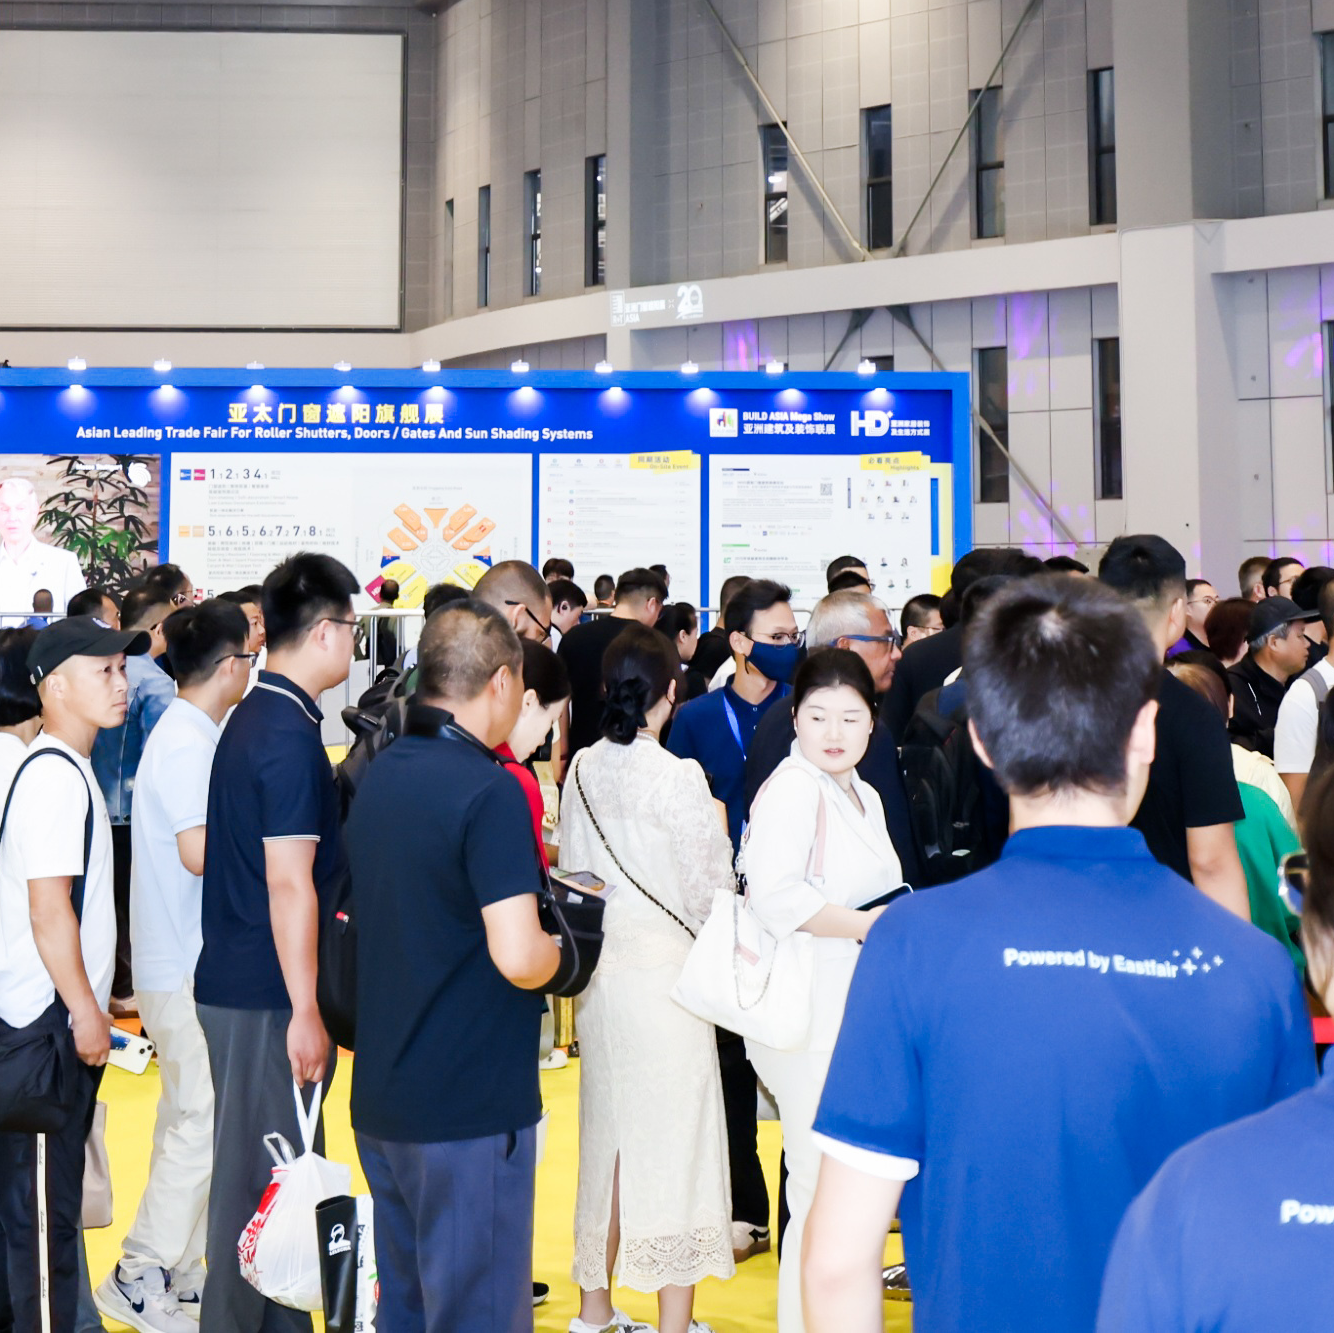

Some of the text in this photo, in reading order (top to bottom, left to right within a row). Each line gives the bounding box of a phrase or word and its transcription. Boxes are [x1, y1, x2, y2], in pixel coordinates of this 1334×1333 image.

[227, 402, 445, 425] 亚太门窗遮阳旗舰展
[743, 411, 835, 423] BUILD ASIA Mega Show
[76, 426, 594, 443] Asian Leading Trade Fair For Roller Shutters, Doors Gates And Sun Shading Systems
[743, 423, 836, 435] 亚洲建筑及装饰联展
[1003, 947, 1179, 978] Powered by Eastfair
